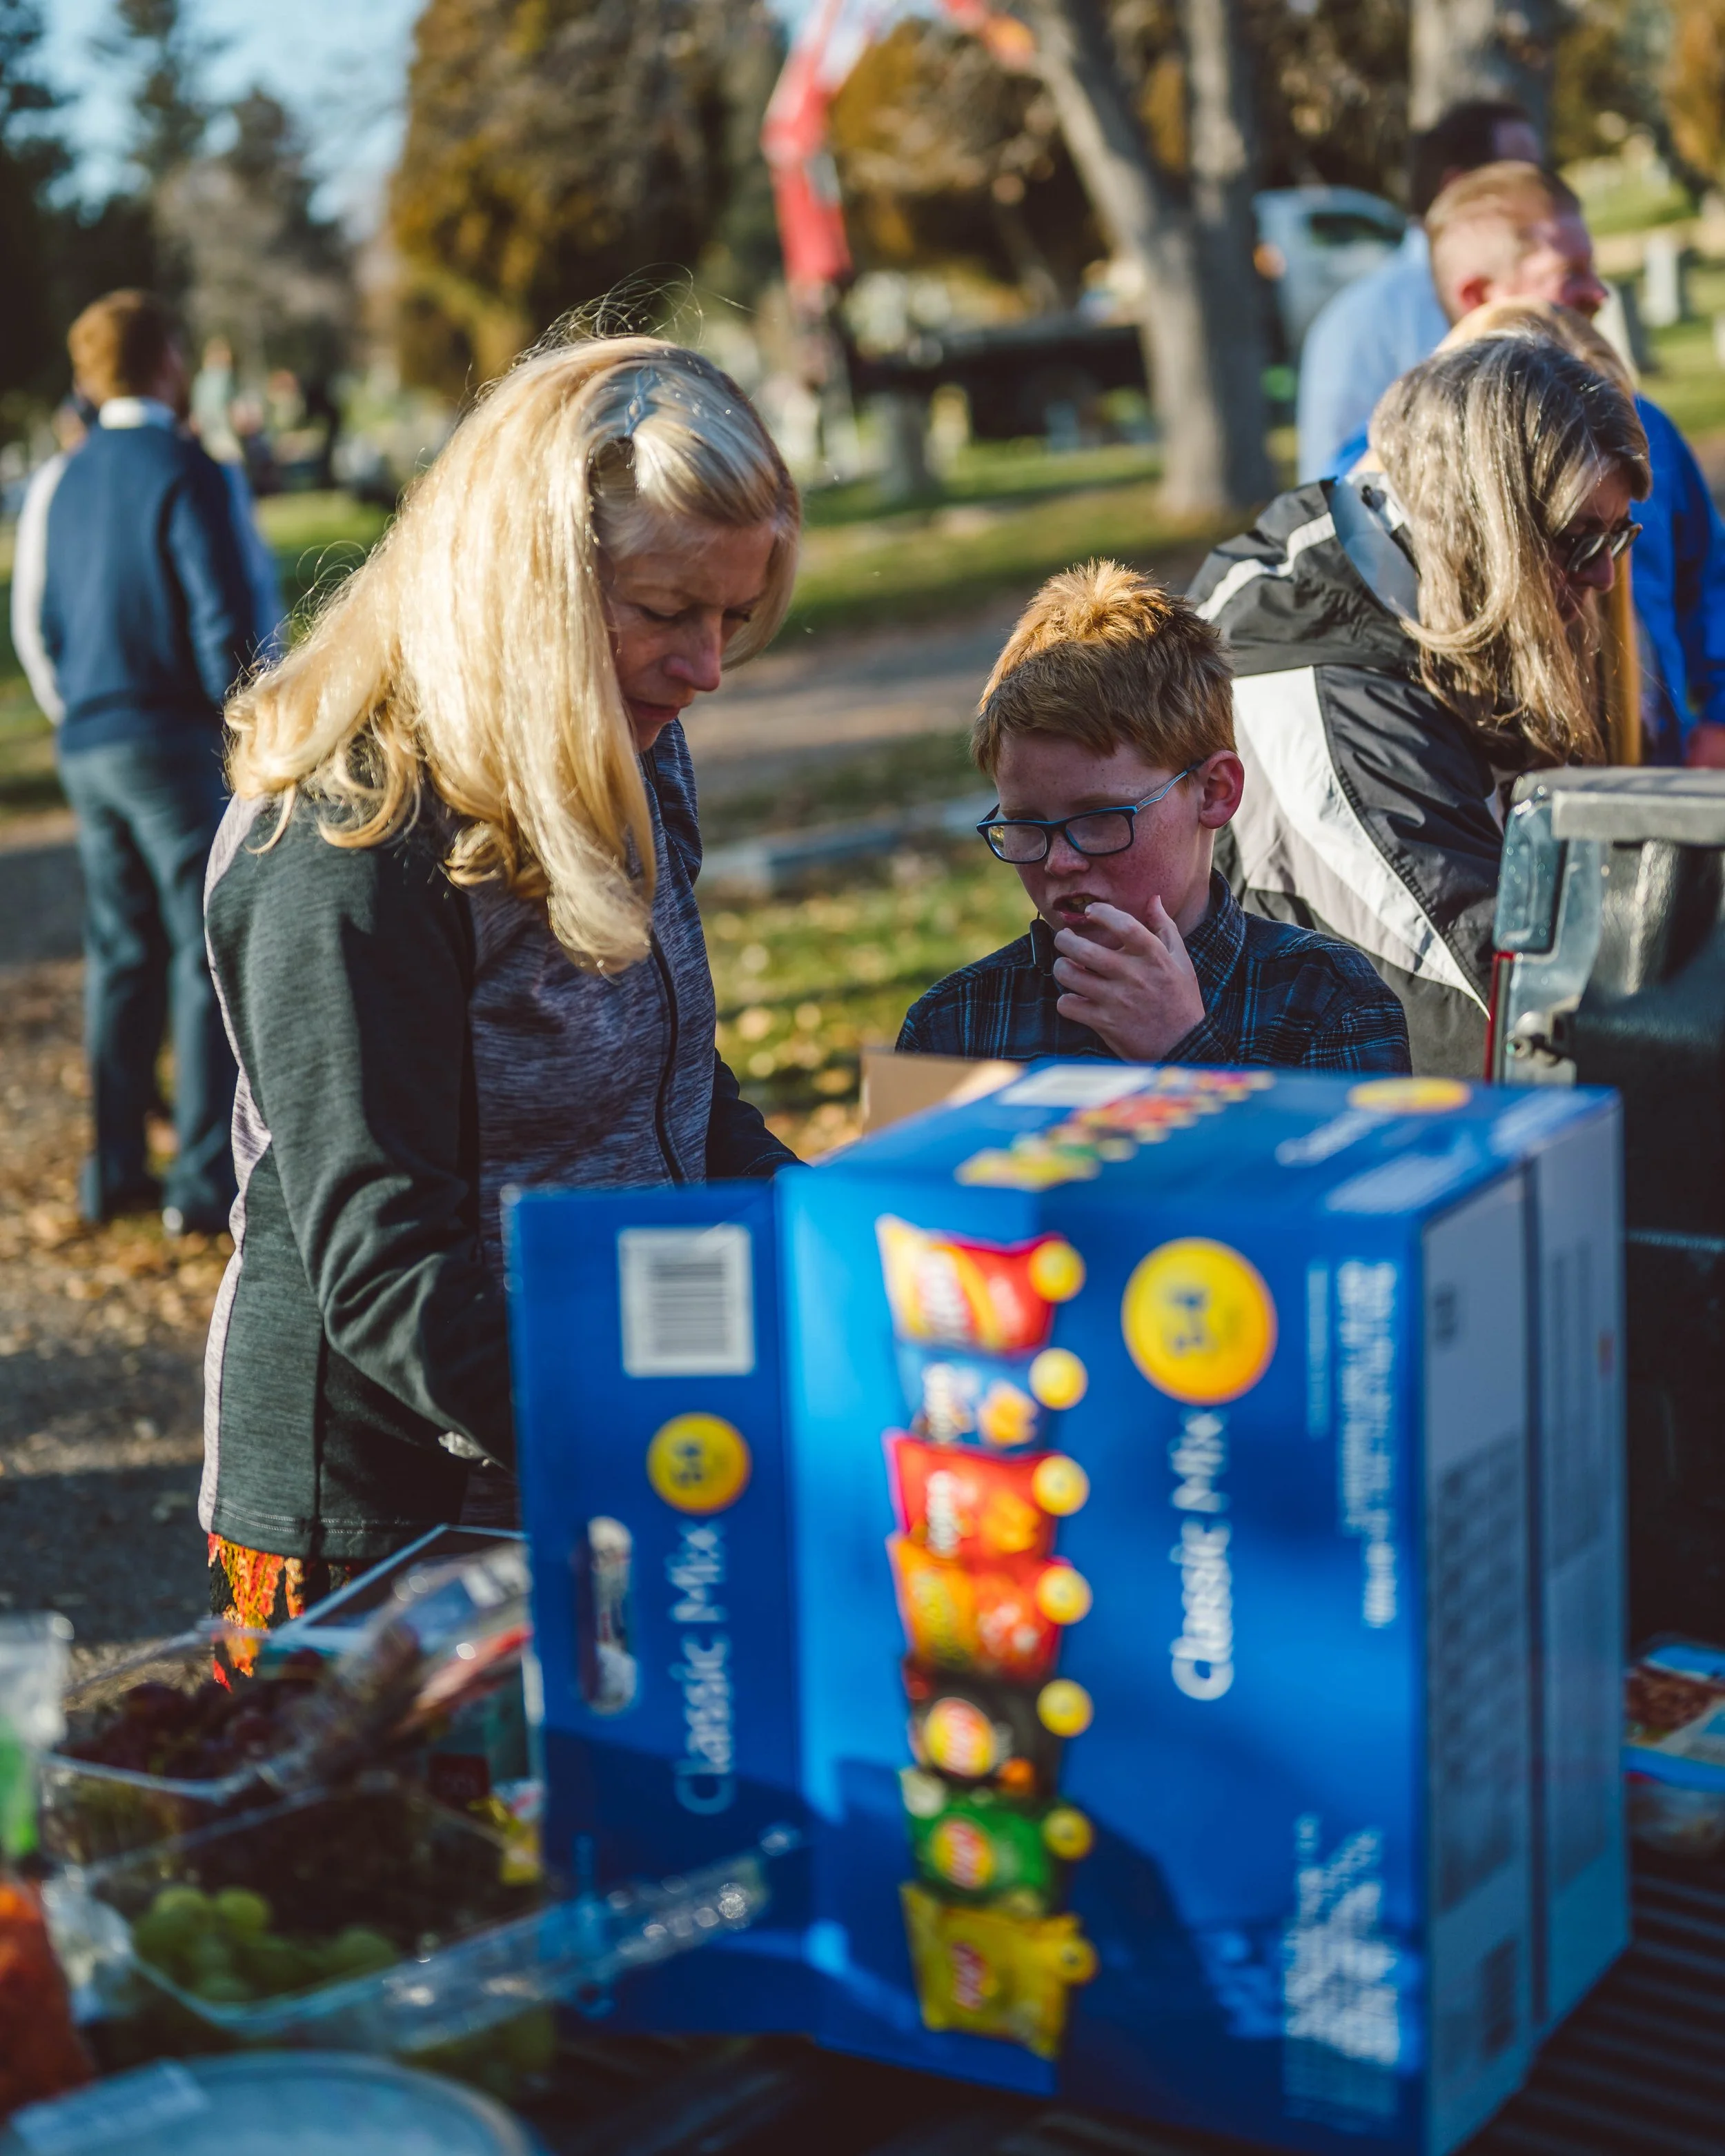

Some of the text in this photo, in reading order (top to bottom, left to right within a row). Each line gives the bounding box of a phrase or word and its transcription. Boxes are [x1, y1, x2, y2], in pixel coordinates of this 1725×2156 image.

[667, 1521, 733, 1814] Classic Mix
[1171, 1410, 1234, 1701] Classic Mix
